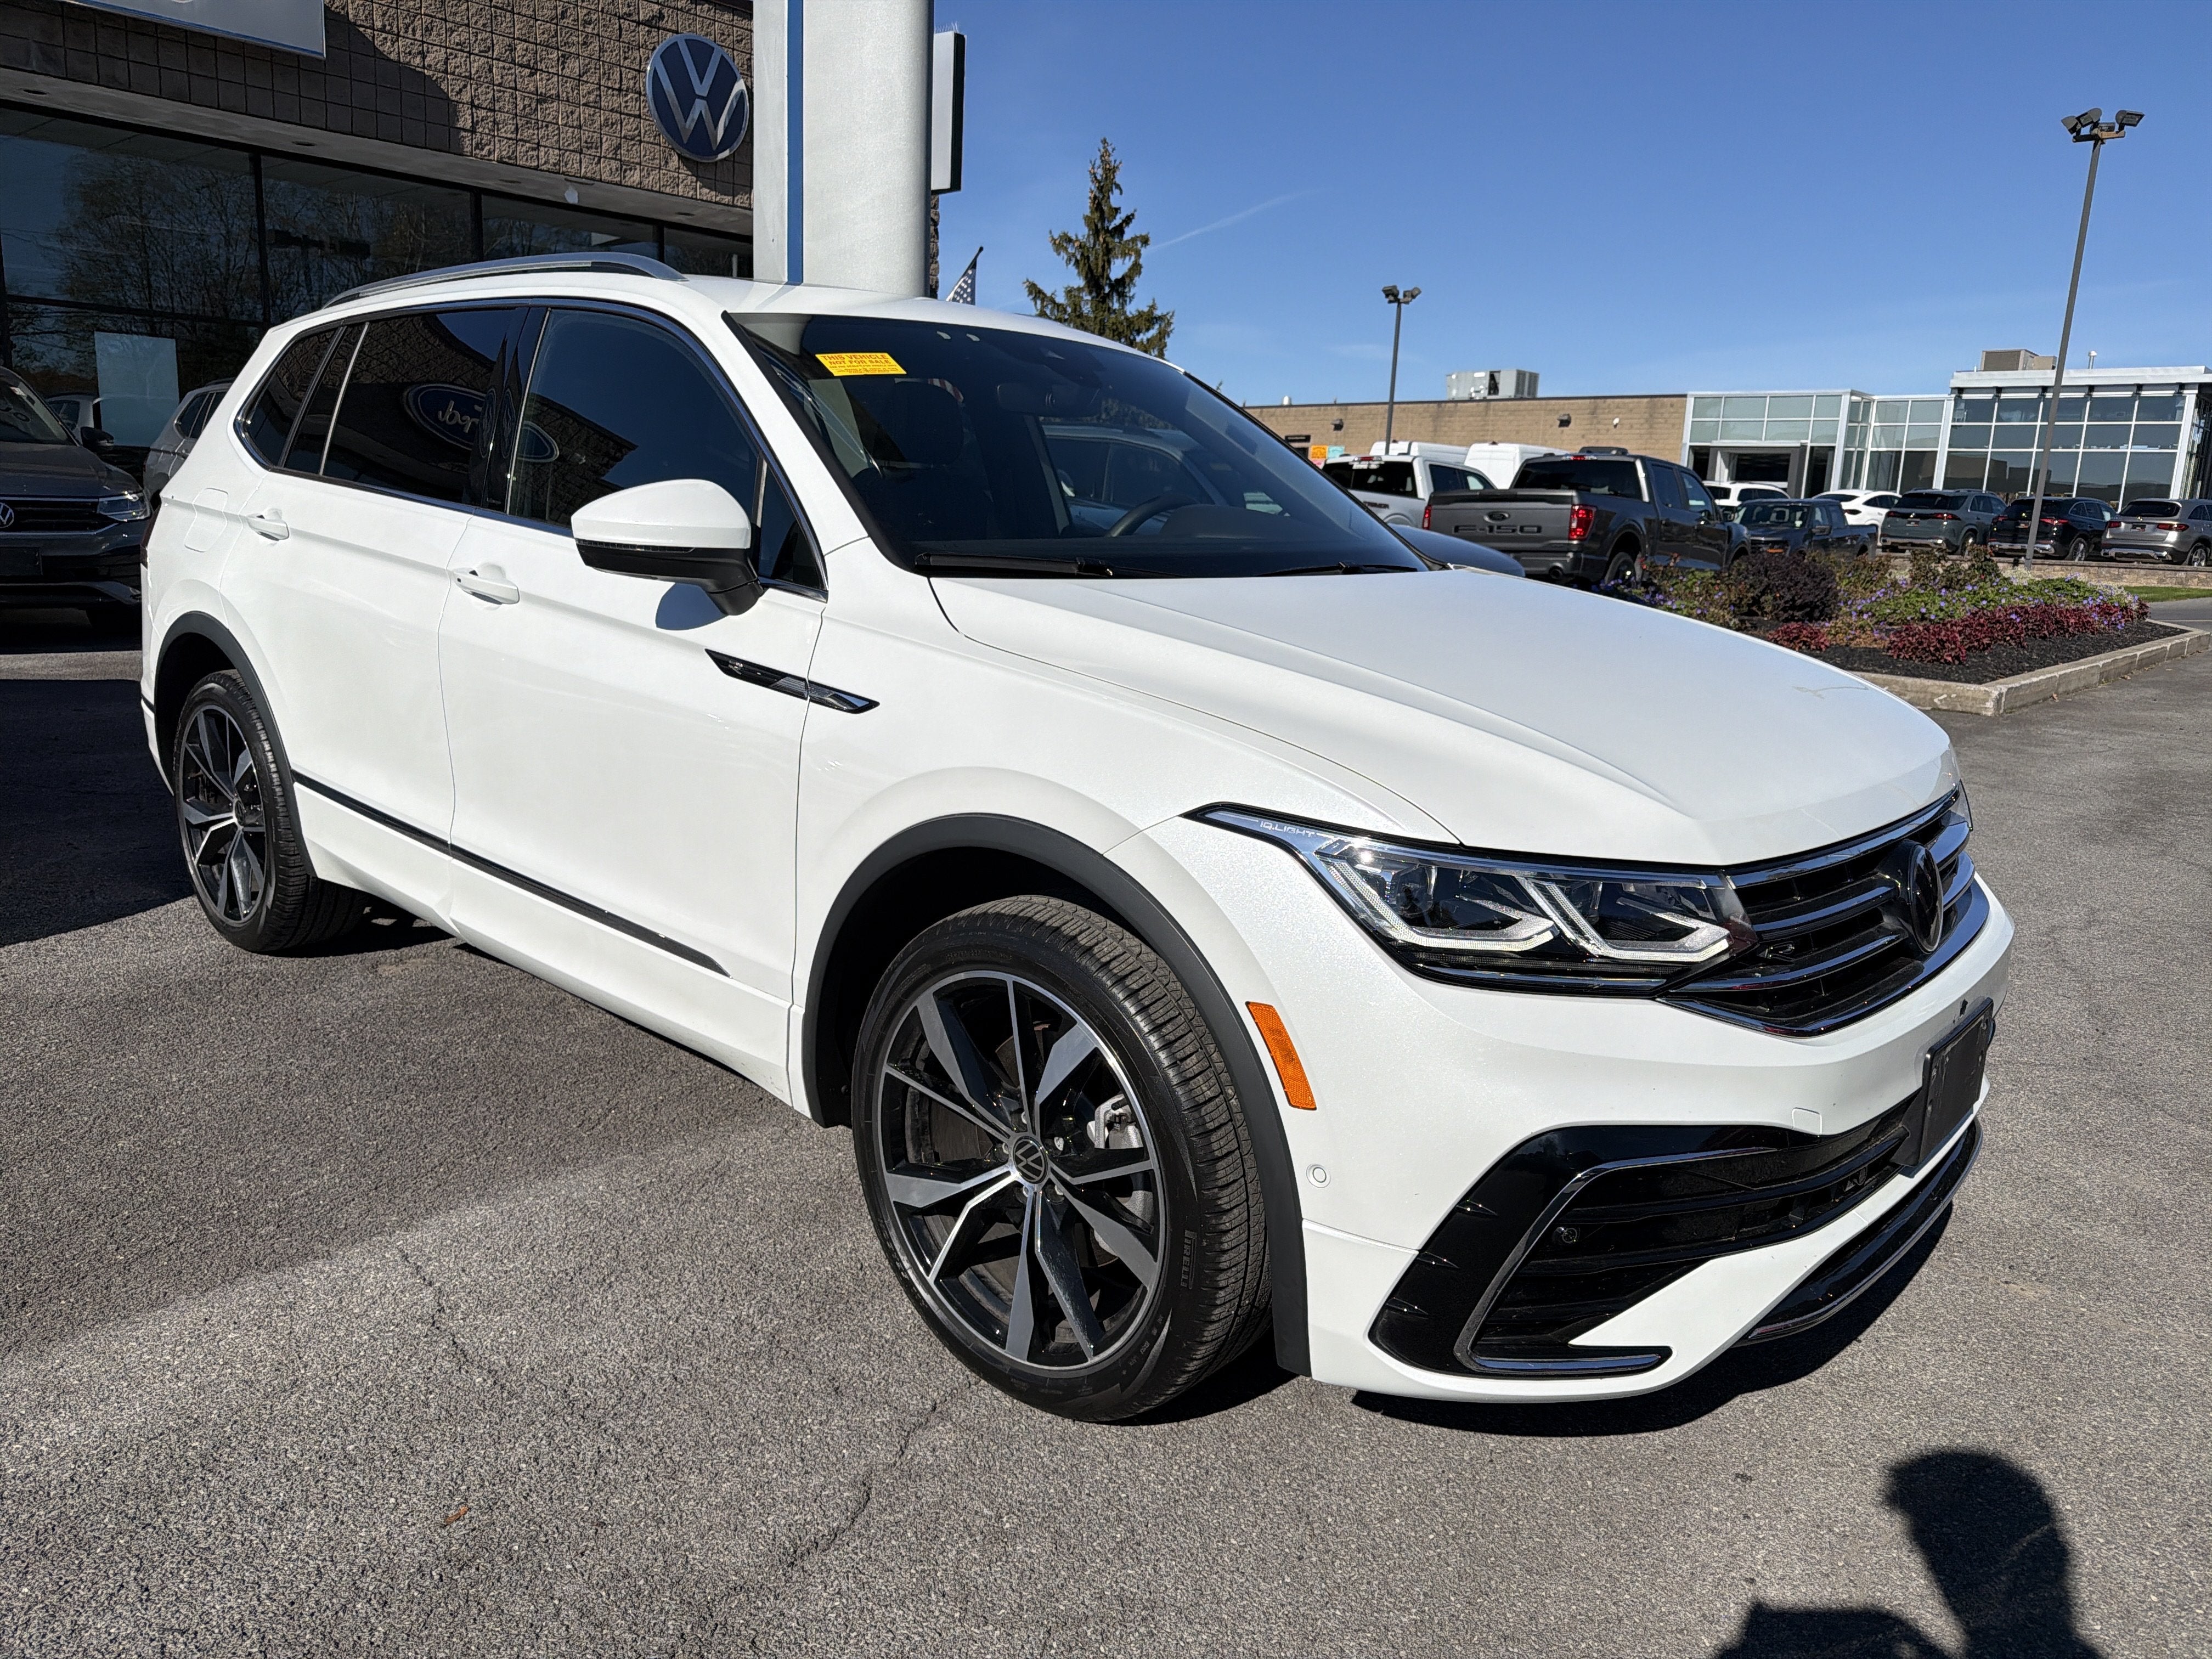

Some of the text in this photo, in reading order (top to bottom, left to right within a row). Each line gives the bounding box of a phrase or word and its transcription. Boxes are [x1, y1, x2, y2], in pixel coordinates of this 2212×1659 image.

[653, 36, 747, 154] VW
[1453, 525, 1543, 535] F-150
[1260, 821, 1315, 837] IQ.LIGHT
[1180, 1229, 1198, 1289] PIRELLI
